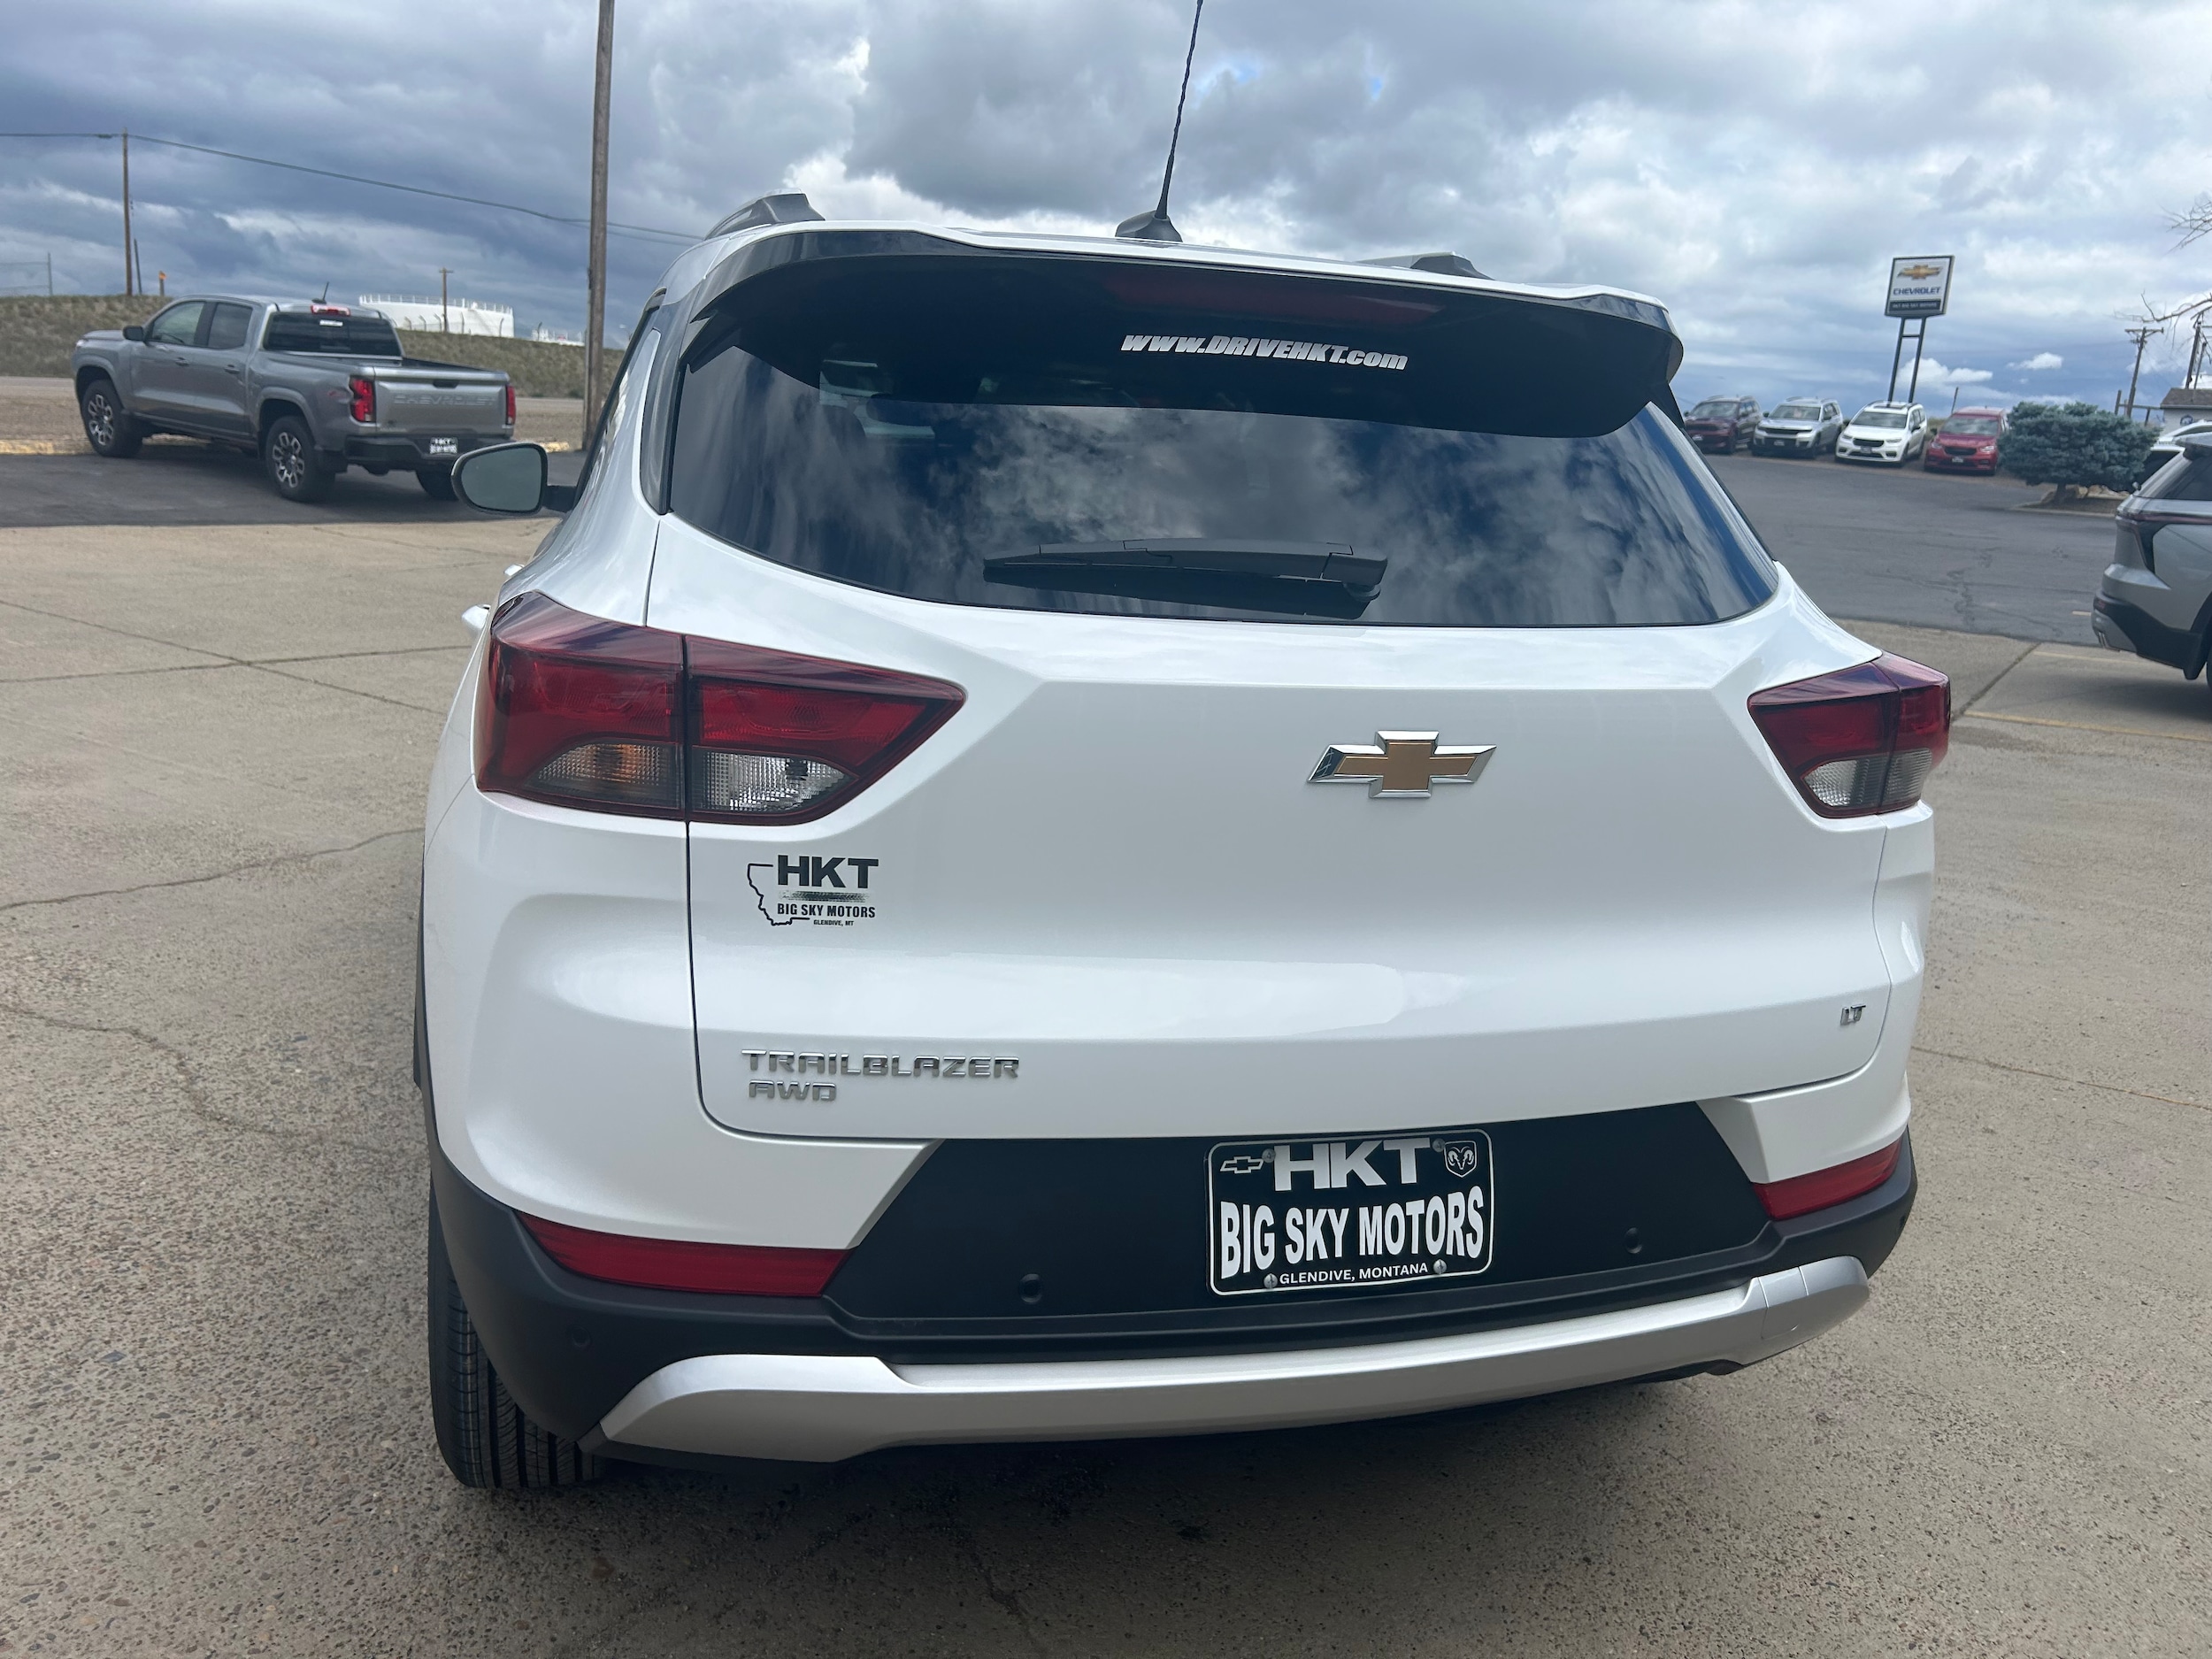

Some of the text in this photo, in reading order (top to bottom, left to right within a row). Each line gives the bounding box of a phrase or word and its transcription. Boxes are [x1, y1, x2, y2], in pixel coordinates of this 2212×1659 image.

[1893, 287, 1941, 296] CHEVROLET
[394, 395, 496, 406] CHEVROLET
[778, 855, 879, 888] HKT
[777, 903, 876, 918] BIG SKY MOTORS
[1840, 1003, 1866, 1025] LT
[741, 1048, 1020, 1078] TRAILBLAZER
[749, 1079, 837, 1102] AWD
[1273, 1137, 1431, 1192] HKT
[1220, 1185, 1485, 1279] BIG SKY MOTORS
[1279, 1263, 1428, 1286] GLENDIVE, MONTANA
